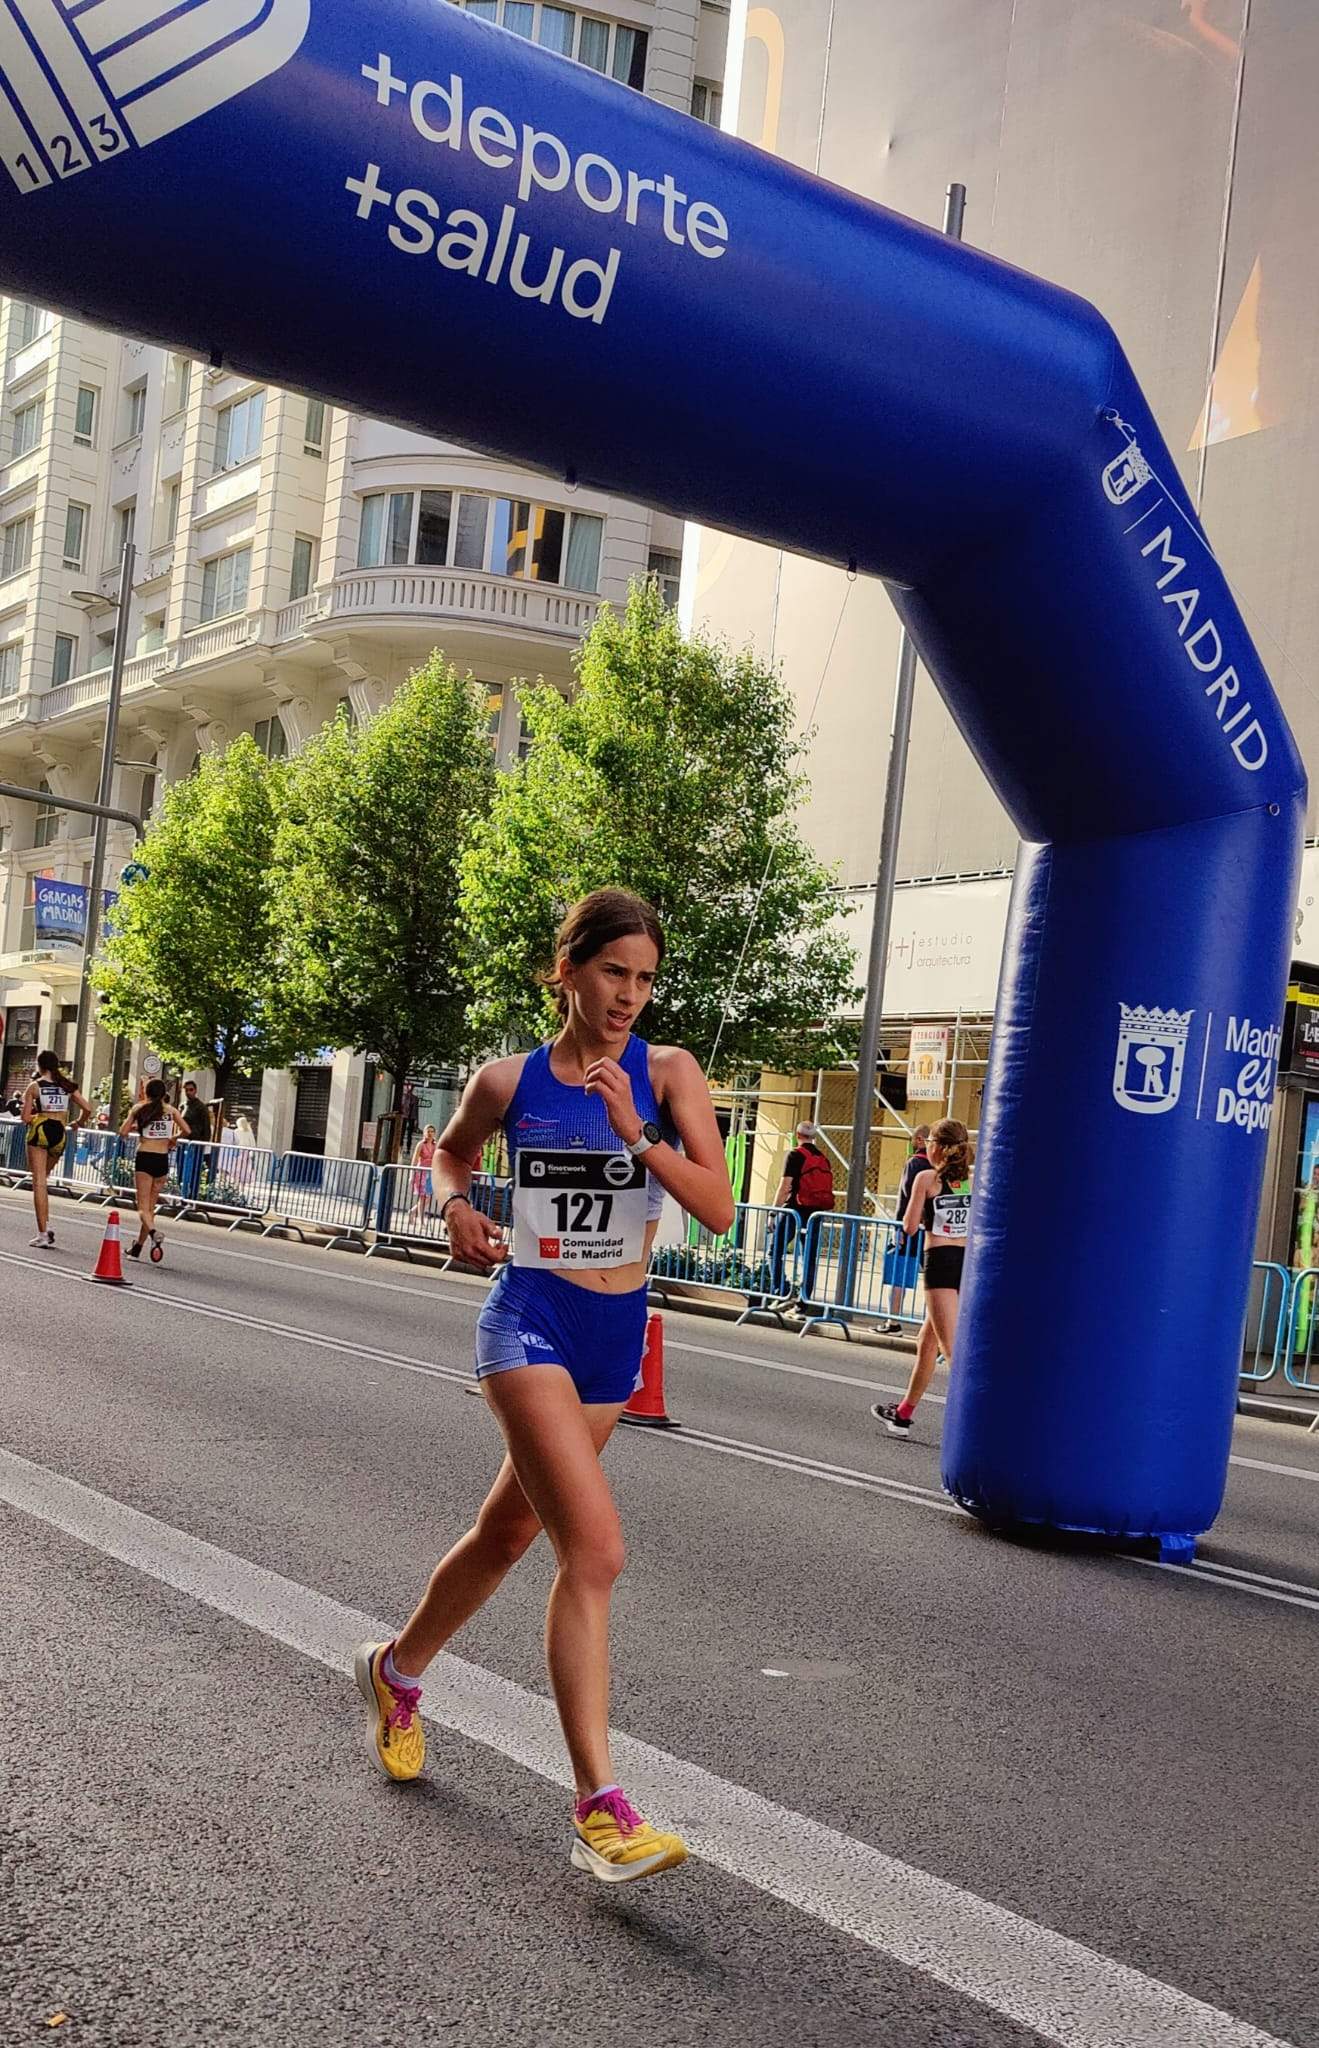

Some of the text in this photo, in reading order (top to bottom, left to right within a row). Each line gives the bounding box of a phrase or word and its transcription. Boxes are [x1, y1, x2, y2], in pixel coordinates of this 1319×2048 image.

[15, 114, 121, 186] 1 2 3
[1140, 526, 1268, 771] MADRID
[39, 887, 84, 909] GRACIAS
[41, 906, 83, 924] MADRID
[918, 934, 974, 948] estudio
[1237, 1058, 1272, 1099] es
[48, 1096, 62, 1104] 271
[150, 1121, 166, 1131] 285
[547, 1163, 587, 1172] finetwork
[551, 1192, 613, 1233] 127
[946, 1209, 967, 1224] 282
[562, 1237, 624, 1248] Comunidad
[562, 1250, 623, 1260] de Madrid
